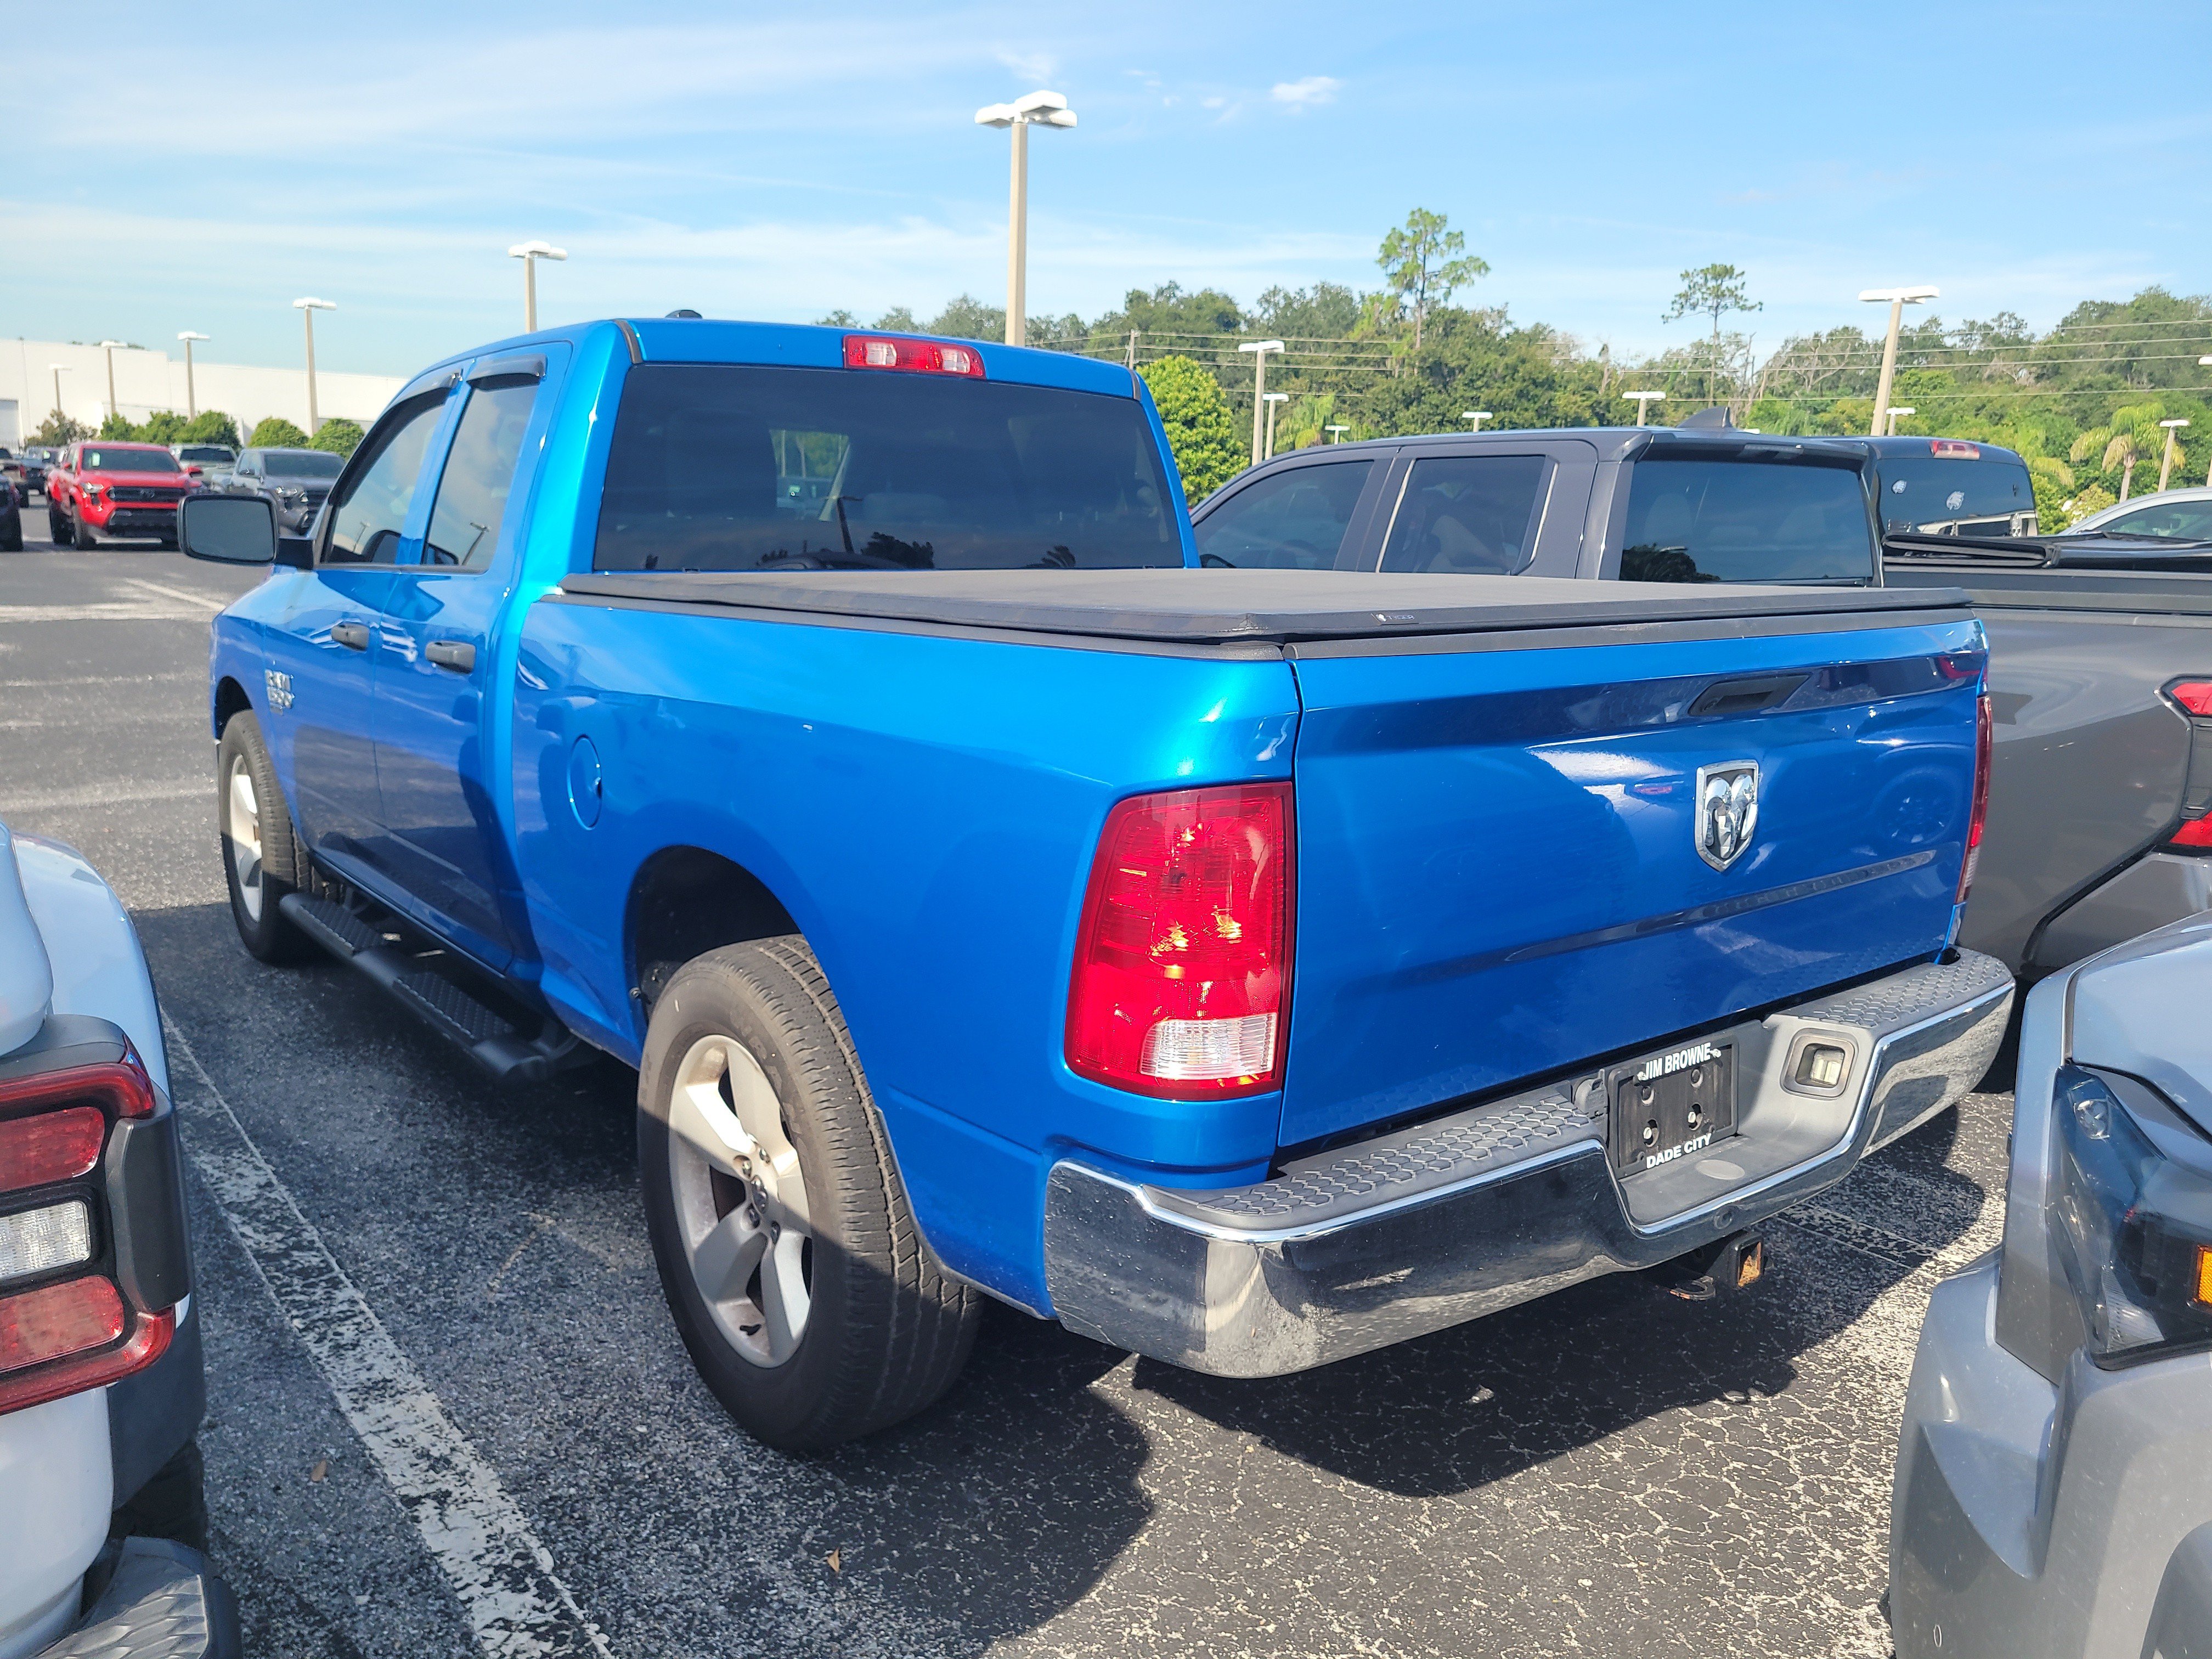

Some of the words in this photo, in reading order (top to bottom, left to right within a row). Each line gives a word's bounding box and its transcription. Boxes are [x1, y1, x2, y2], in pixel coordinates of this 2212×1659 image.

[1645, 1058, 1663, 1081] JIM
[1664, 1042, 1711, 1074] BROWNE
[1646, 1144, 1681, 1169] DADE
[1684, 1133, 1712, 1154] CITY
